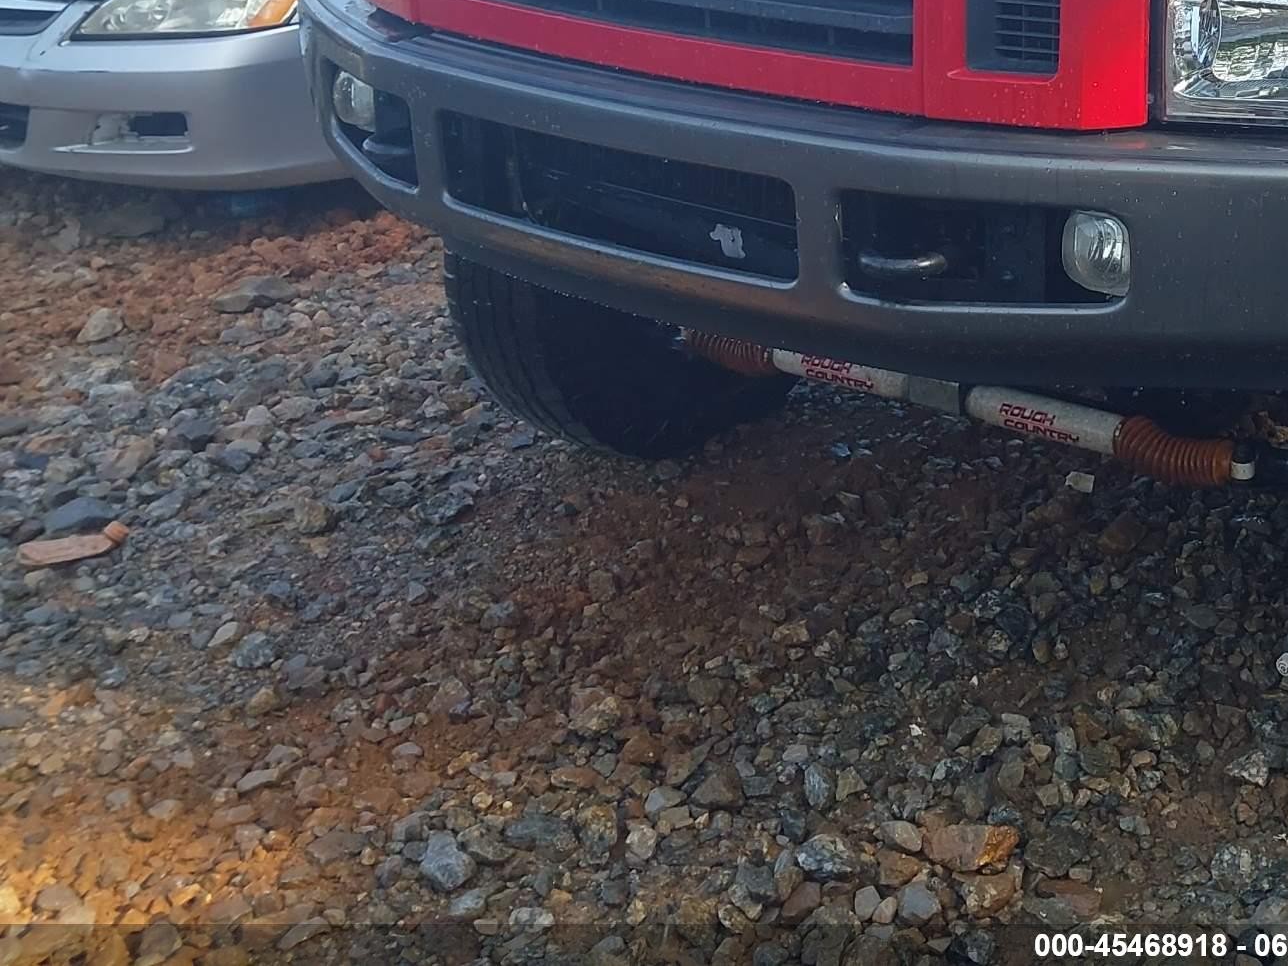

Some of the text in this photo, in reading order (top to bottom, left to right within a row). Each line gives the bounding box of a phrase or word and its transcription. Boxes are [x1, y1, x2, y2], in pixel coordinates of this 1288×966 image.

[801, 353, 852, 374] ROUGH
[805, 368, 875, 390] COUNTRY
[999, 402, 1056, 426] ROUGH
[1004, 419, 1080, 442] COUNTRY
